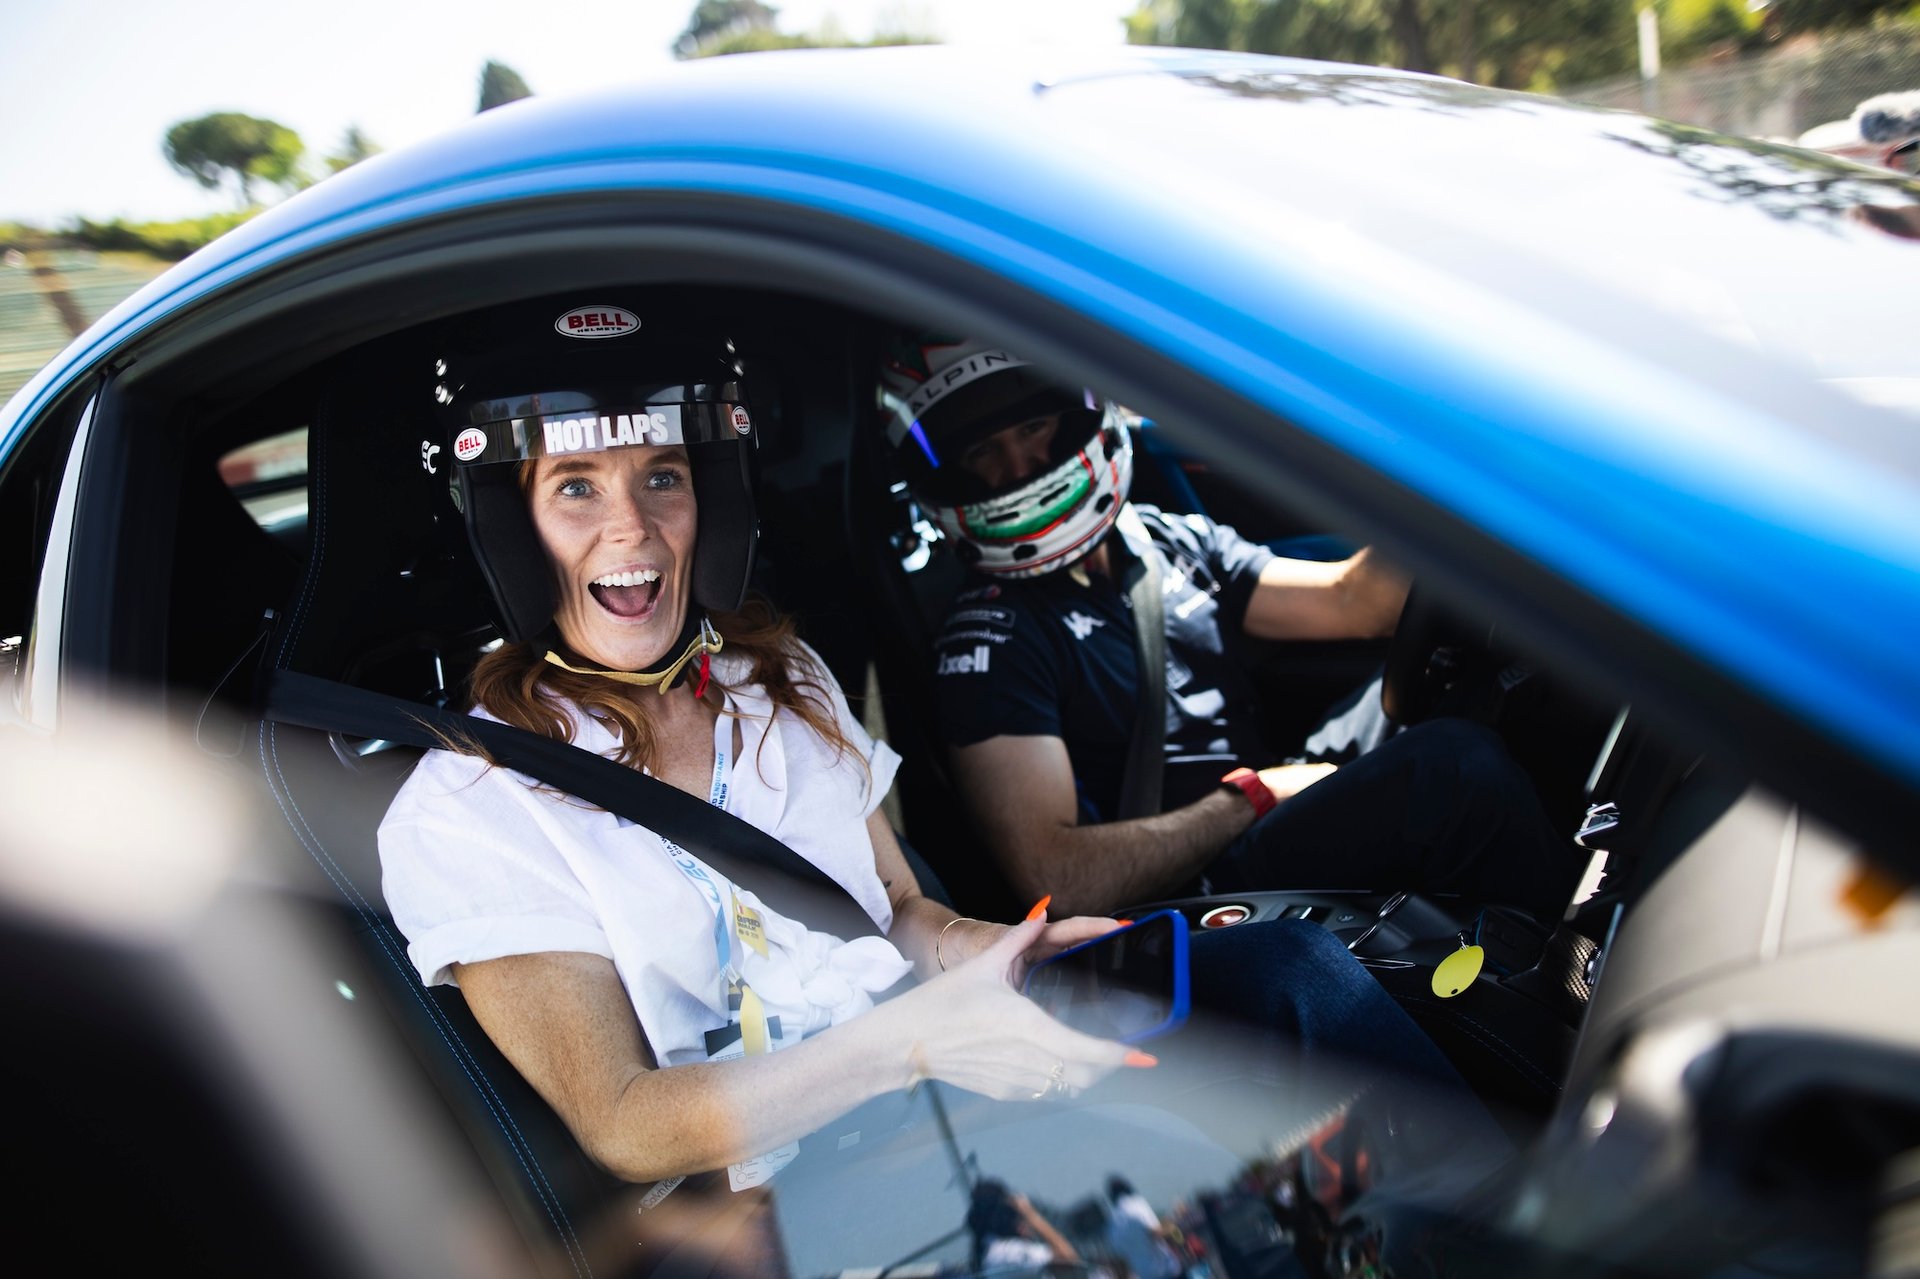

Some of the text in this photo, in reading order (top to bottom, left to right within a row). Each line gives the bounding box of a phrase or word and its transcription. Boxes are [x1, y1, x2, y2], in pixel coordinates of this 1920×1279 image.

[567, 313, 629, 329] BELL
[911, 350, 1009, 413] ALPIN
[458, 435, 481, 453] BELL
[543, 412, 669, 454] HOT LAPS
[713, 752, 724, 797] ENDURANCE
